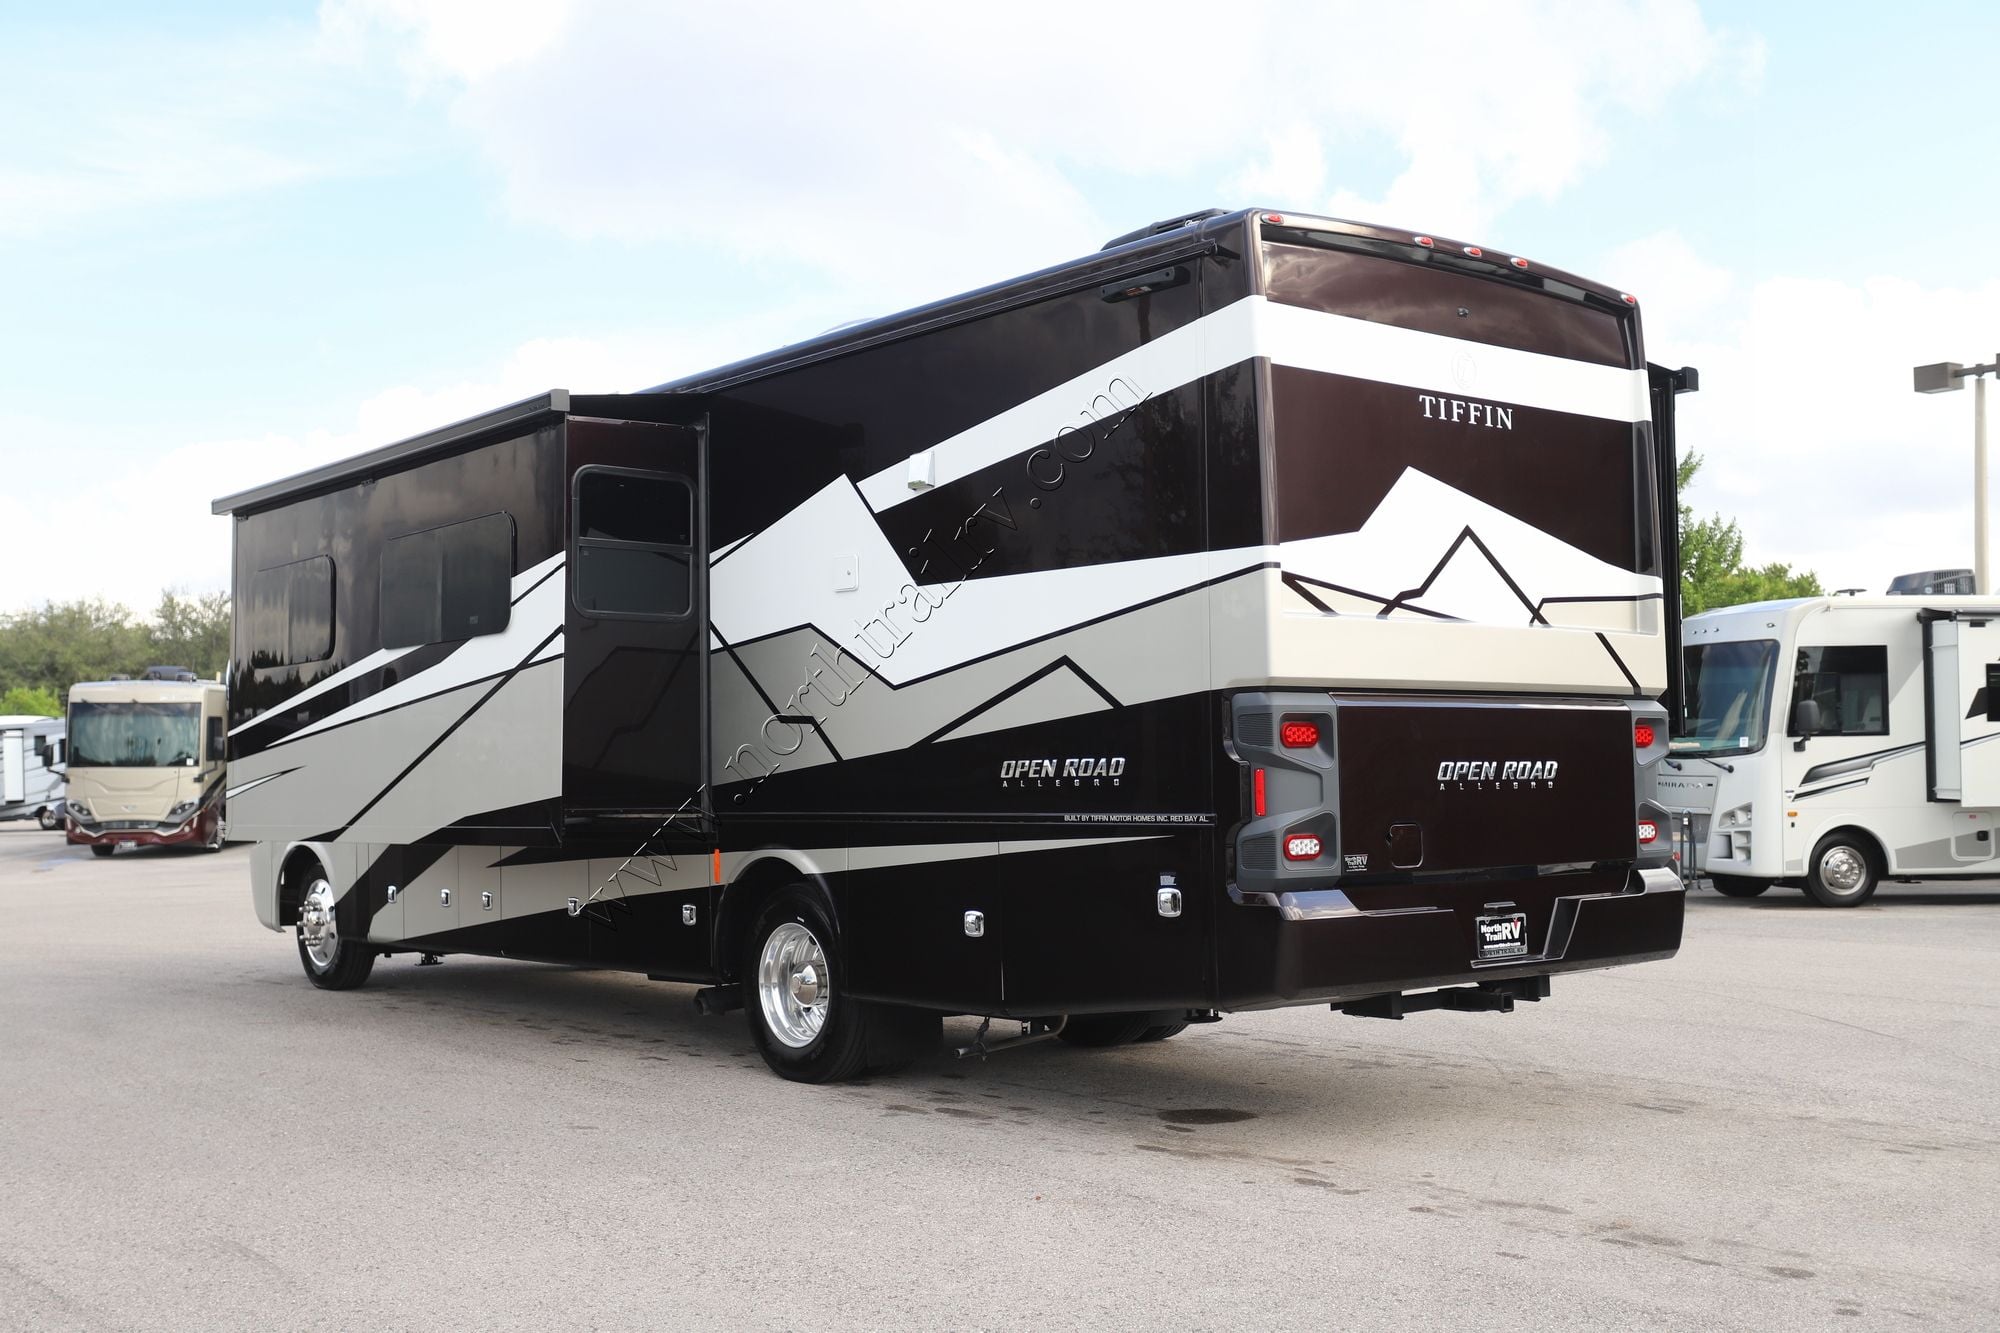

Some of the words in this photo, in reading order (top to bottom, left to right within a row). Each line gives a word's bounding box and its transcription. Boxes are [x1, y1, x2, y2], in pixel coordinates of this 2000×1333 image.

[1419, 394, 1512, 430] TIFFIN
[1000, 759, 1057, 778] OPEN
[1063, 757, 1125, 777] ROAD
[1437, 761, 1497, 780] OPEN
[1502, 760, 1558, 780] ROAD
[1002, 778, 1120, 788] ALLEGRO
[1440, 781, 1553, 790] ALLEGRO
[1481, 924, 1502, 933] North
[1502, 922, 1521, 939] RV
[1485, 932, 1502, 941] Trail
